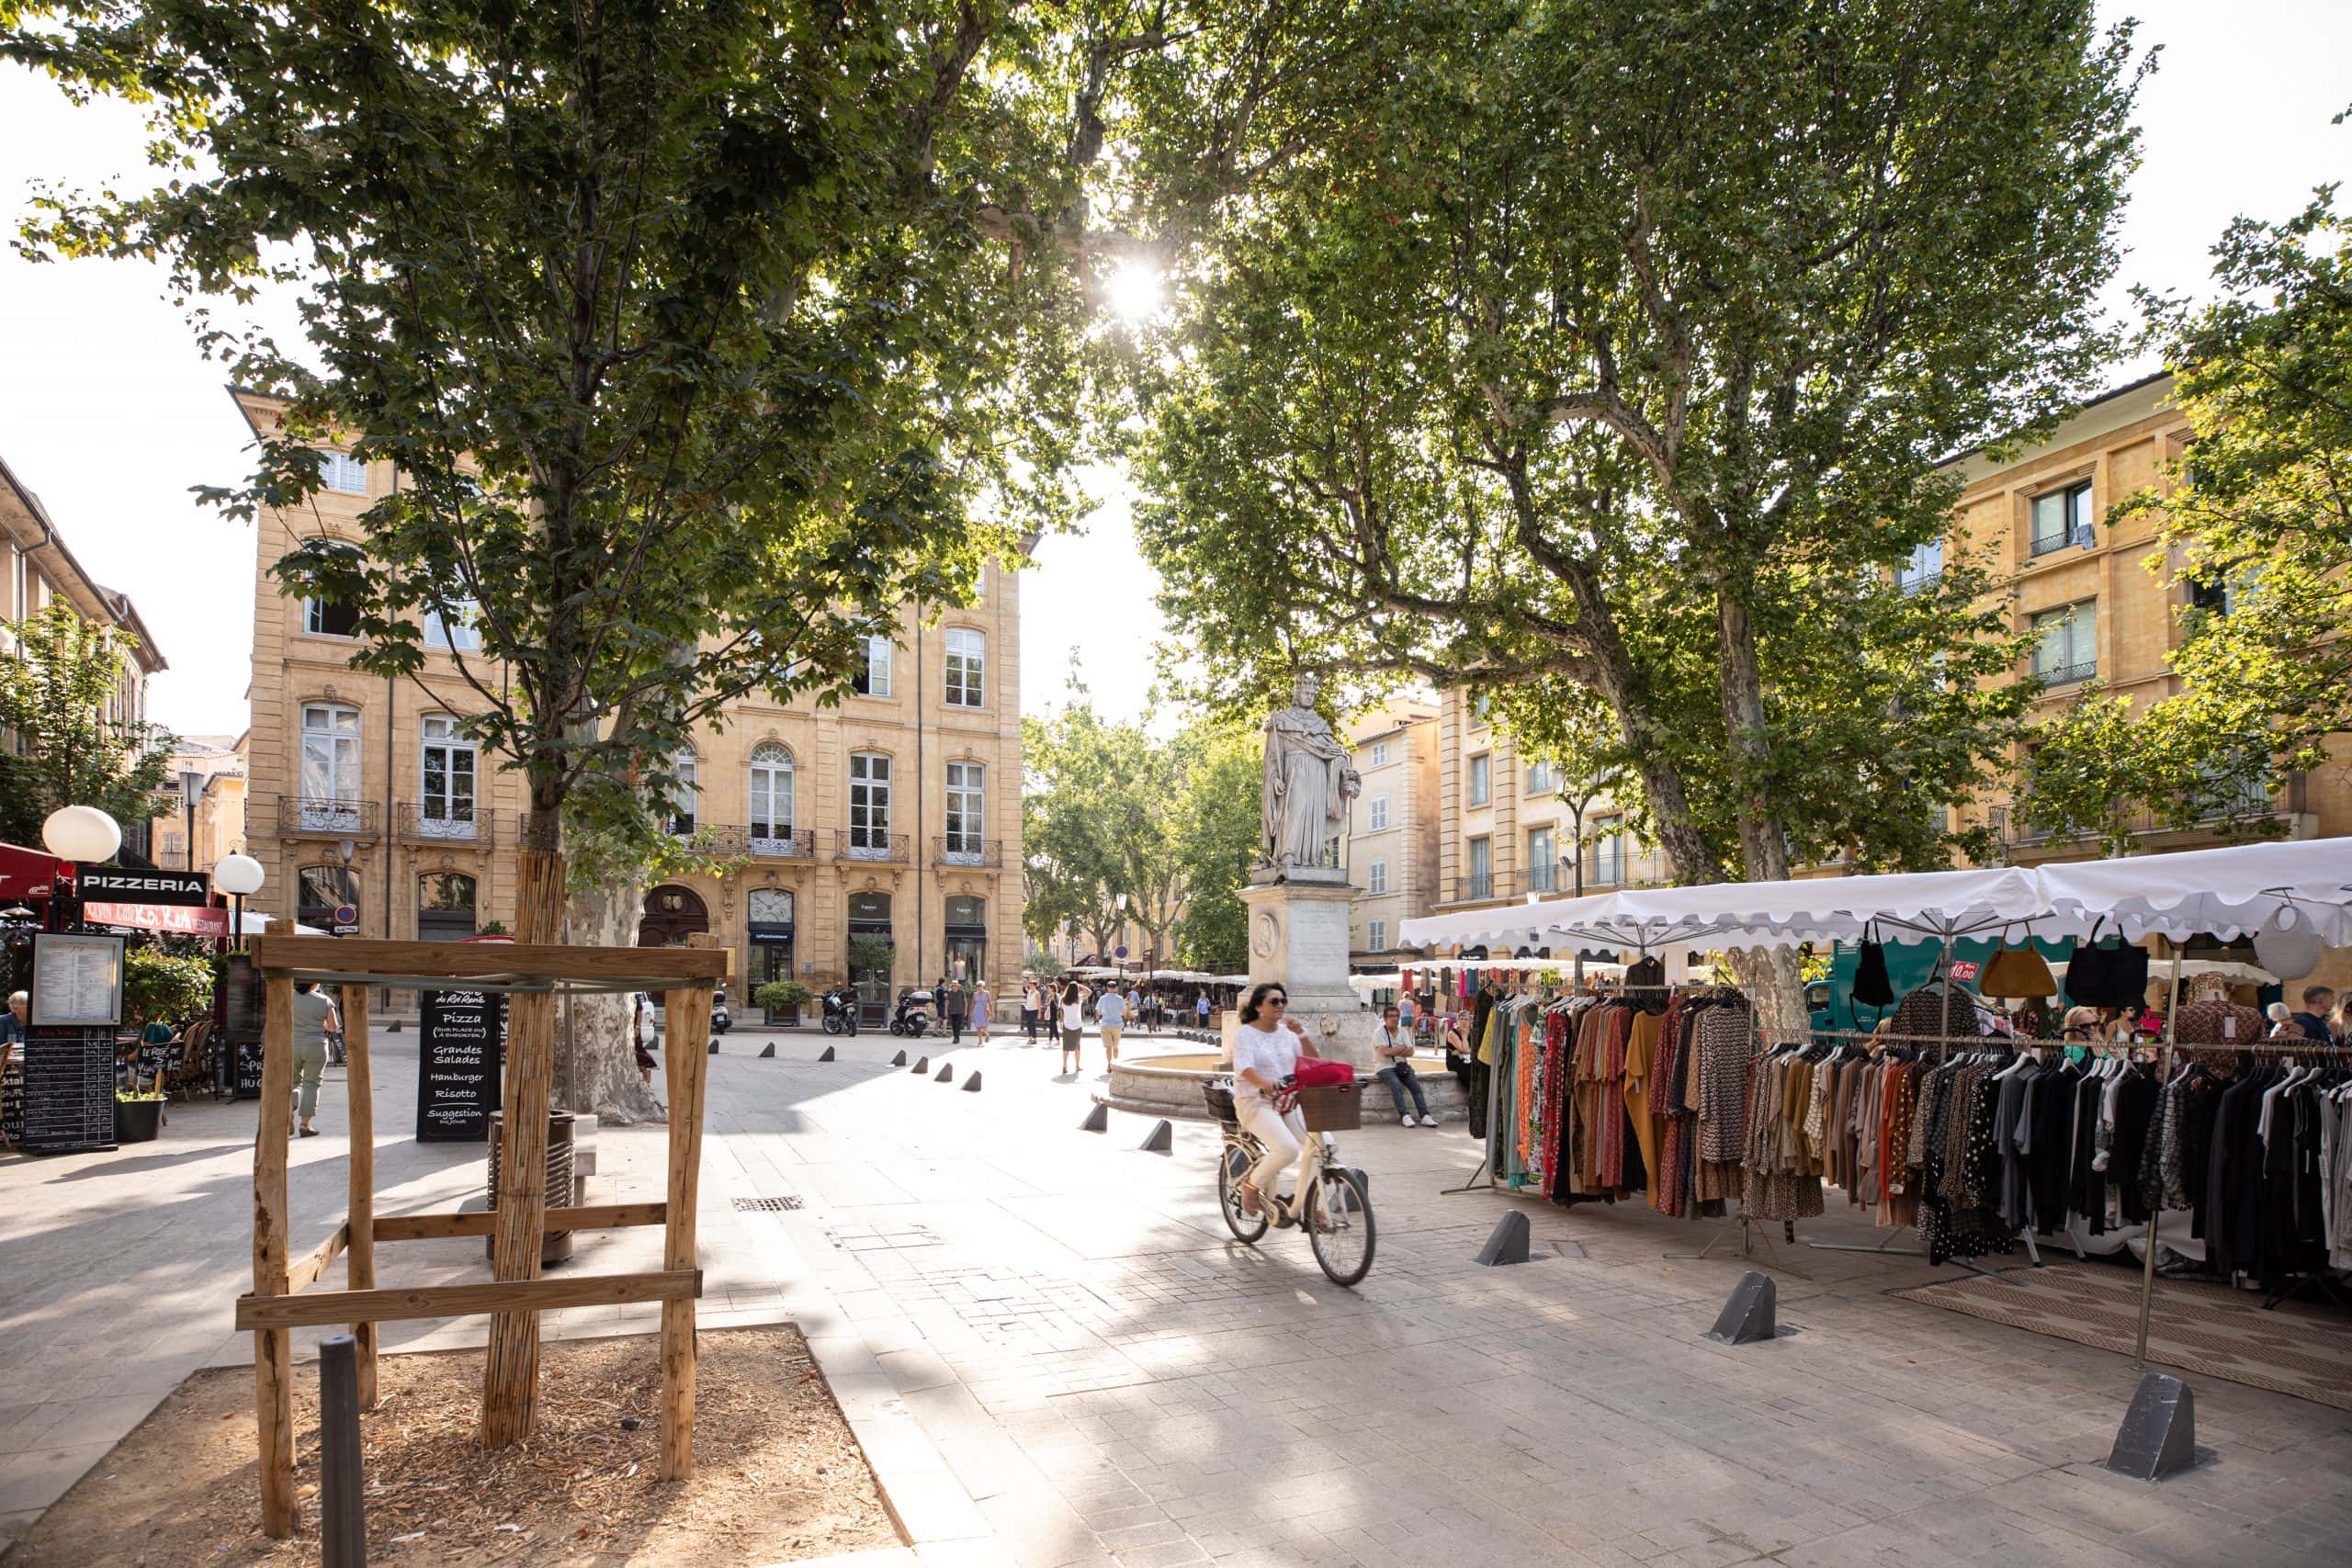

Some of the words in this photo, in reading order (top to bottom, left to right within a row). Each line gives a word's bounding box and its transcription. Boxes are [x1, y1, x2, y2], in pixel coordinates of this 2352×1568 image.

[84, 874, 204, 892] PIZZERIA
[443, 1011, 481, 1023] Pizza
[433, 1044, 482, 1055] Grandes
[433, 1055, 481, 1065] Salades
[239, 1060, 264, 1073] SPR
[430, 1072, 484, 1084] Hamburger
[435, 1088, 477, 1098] Risotto
[426, 1108, 483, 1120] Suggestion
